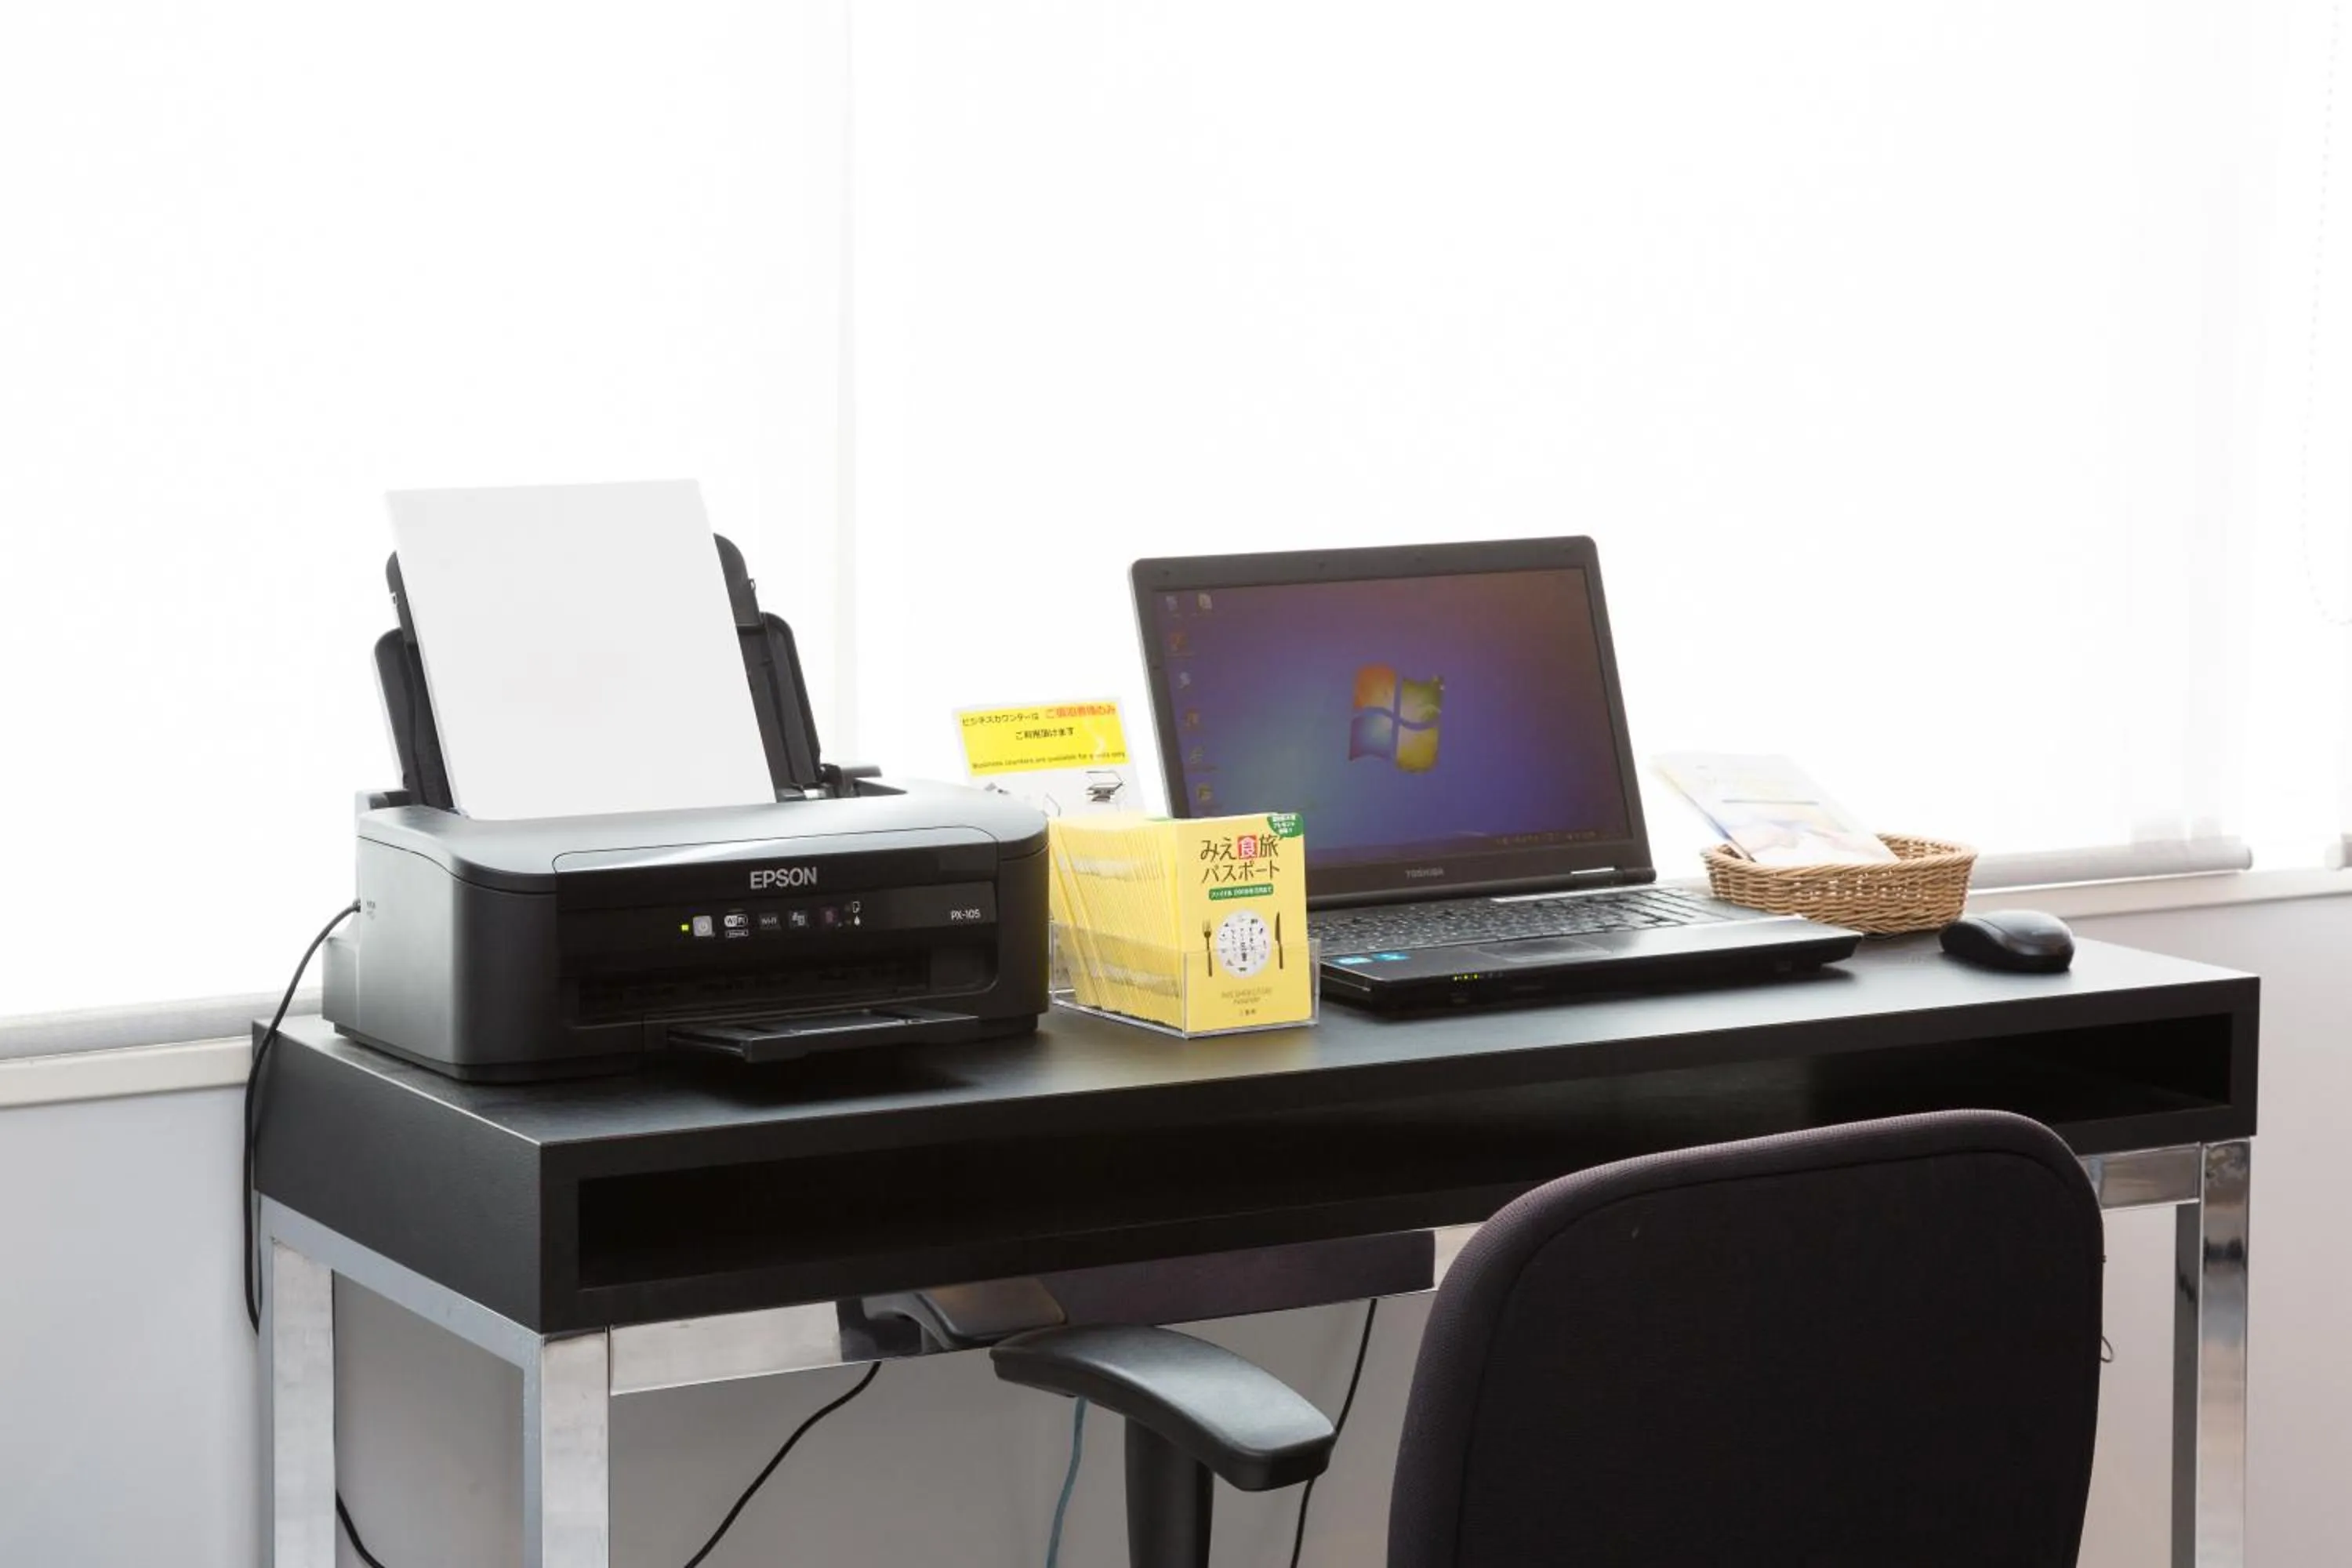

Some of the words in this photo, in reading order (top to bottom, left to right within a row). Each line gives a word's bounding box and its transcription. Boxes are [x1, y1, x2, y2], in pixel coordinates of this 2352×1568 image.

[1200, 833, 1279, 862] みえ食旅
[750, 866, 817, 890] EPSON
[1202, 859, 1279, 884] パスポート
[951, 909, 981, 920] PX-105
